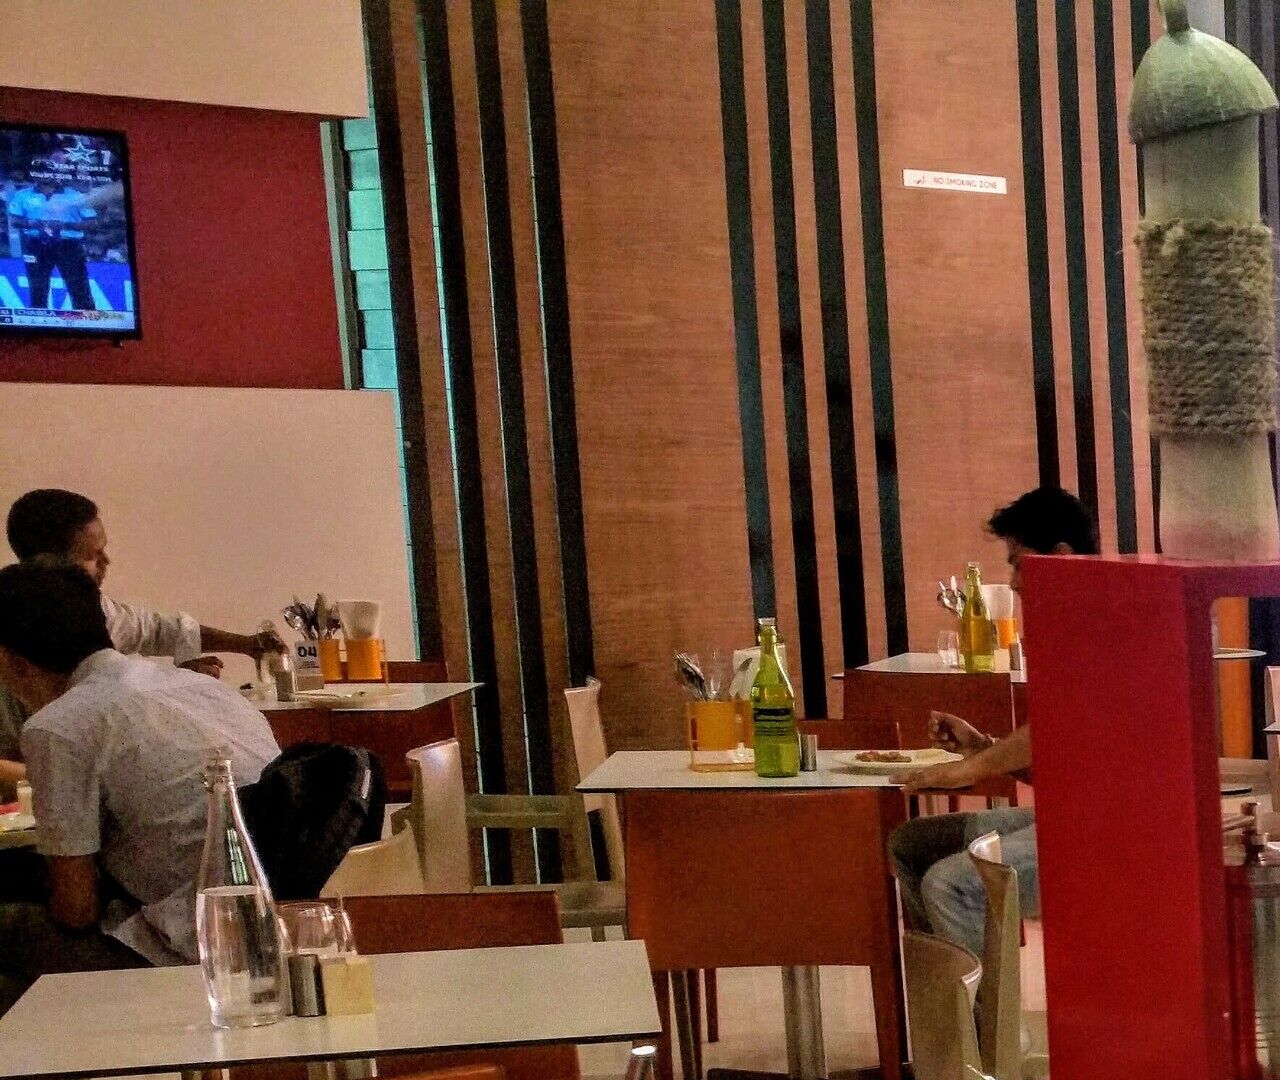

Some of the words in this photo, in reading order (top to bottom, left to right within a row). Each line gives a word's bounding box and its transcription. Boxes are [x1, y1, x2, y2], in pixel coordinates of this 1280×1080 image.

[933, 177, 944, 185] NO
[946, 178, 977, 188] SMOKING
[979, 180, 998, 189] ZONE
[297, 646, 317, 658] 04
